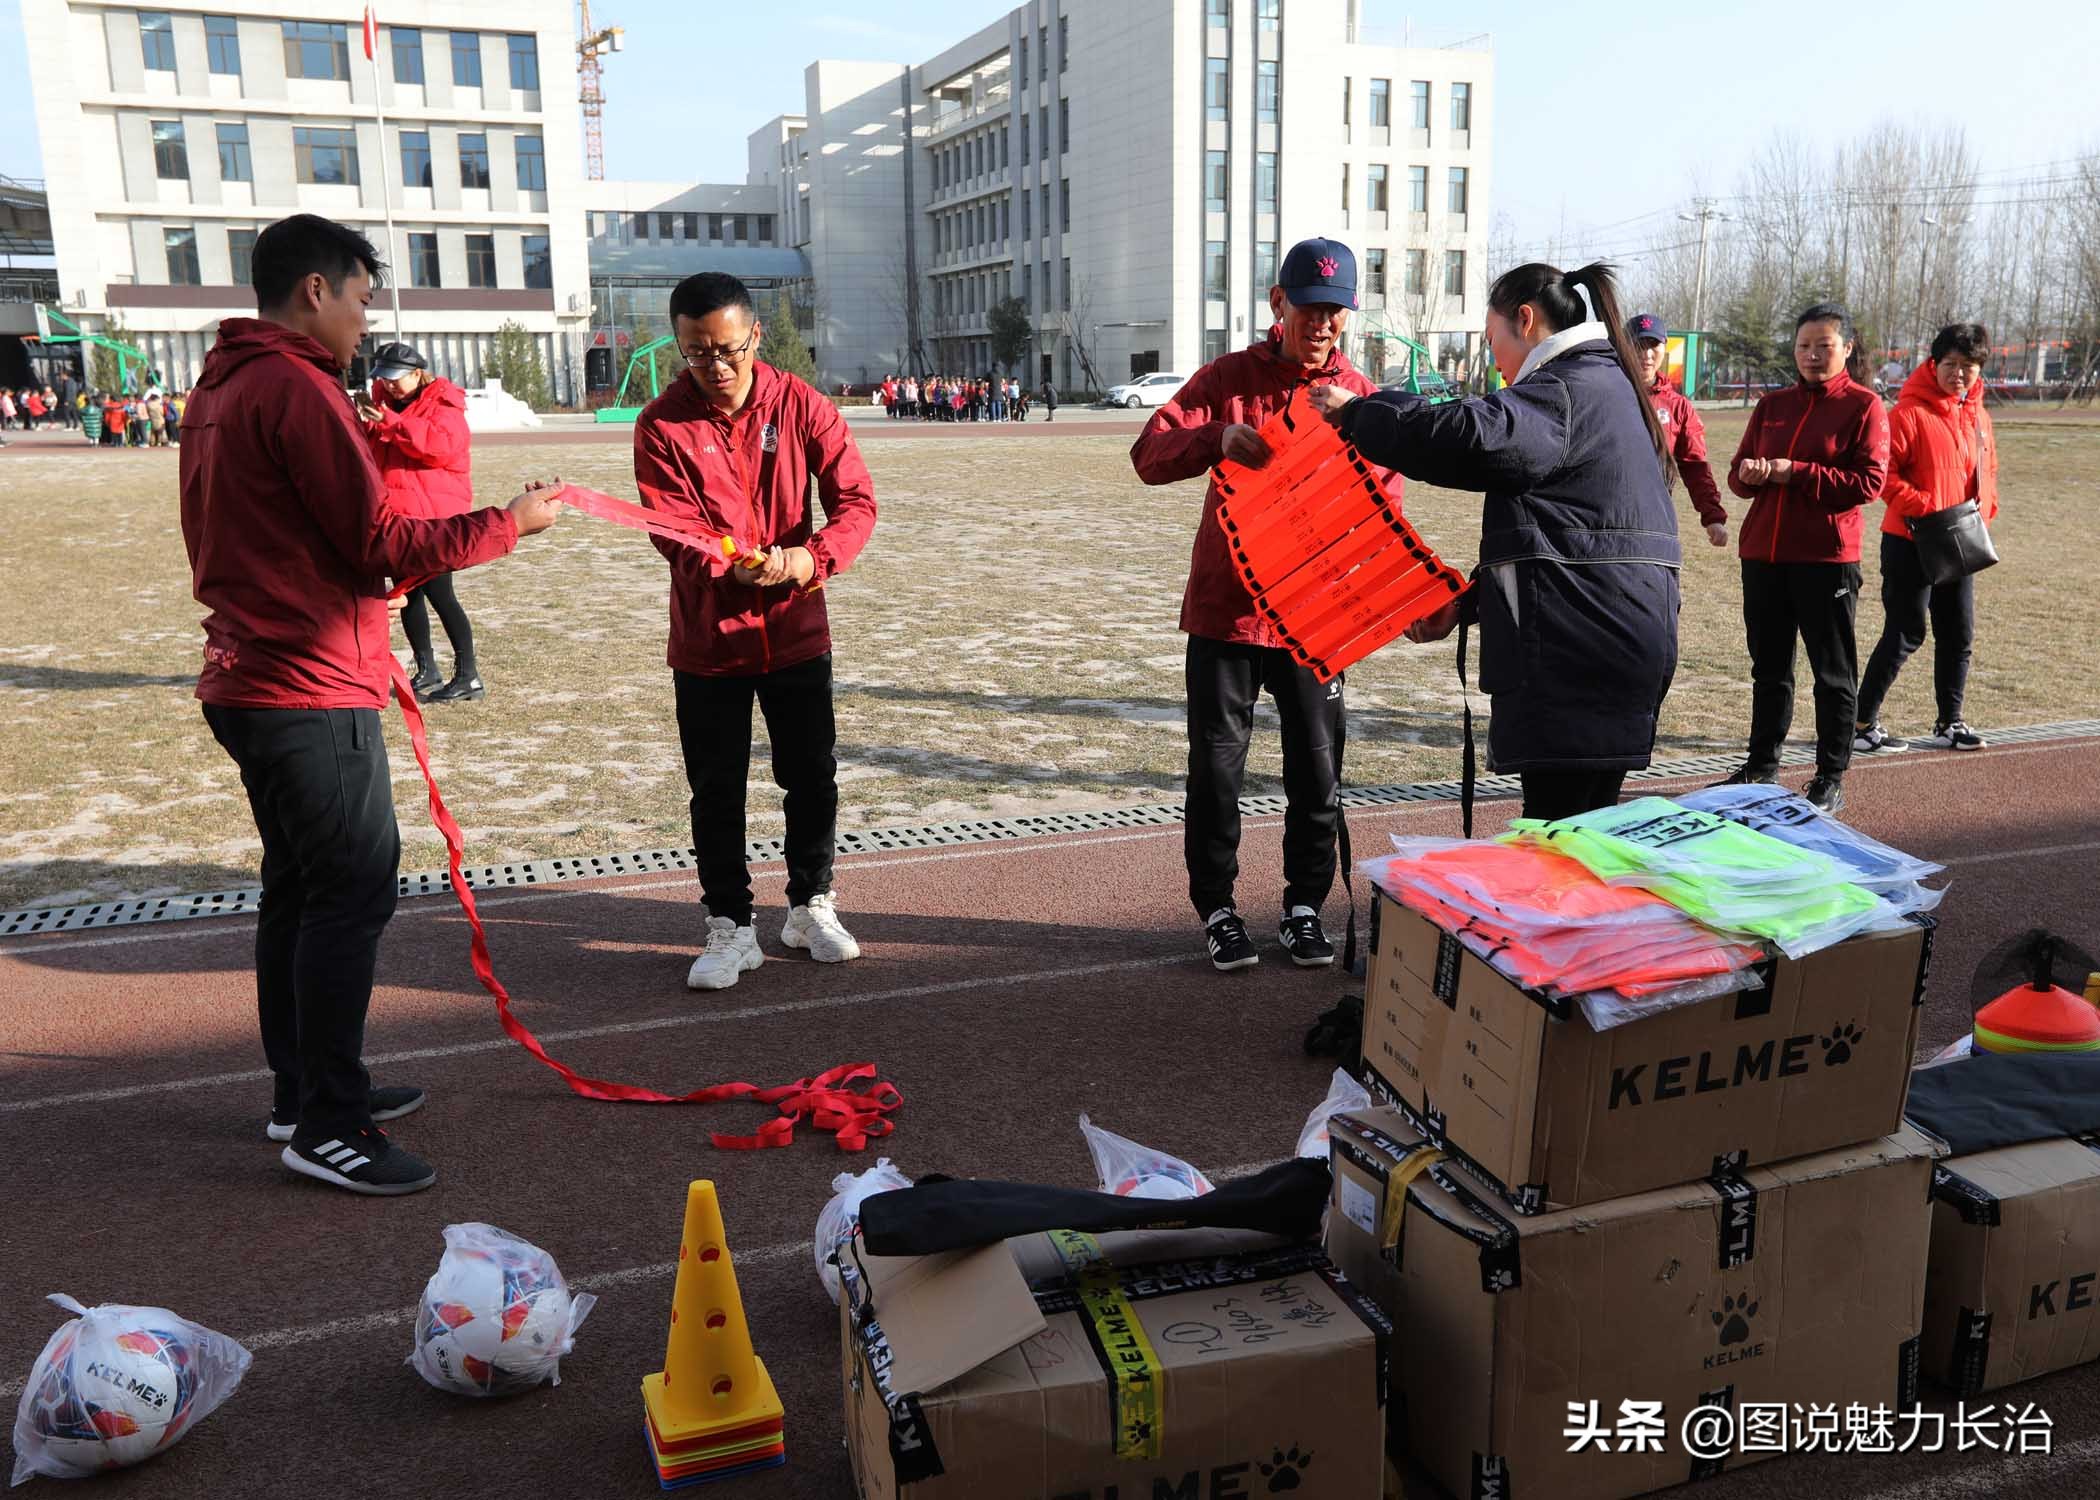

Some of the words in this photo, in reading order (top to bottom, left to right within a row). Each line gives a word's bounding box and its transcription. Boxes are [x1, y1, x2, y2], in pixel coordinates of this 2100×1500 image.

[1608, 1035, 1815, 1110] KELME
[1099, 1304, 1151, 1383] KELME
[1703, 1344, 1765, 1369] KELME
[86, 1361, 157, 1403] KELME
